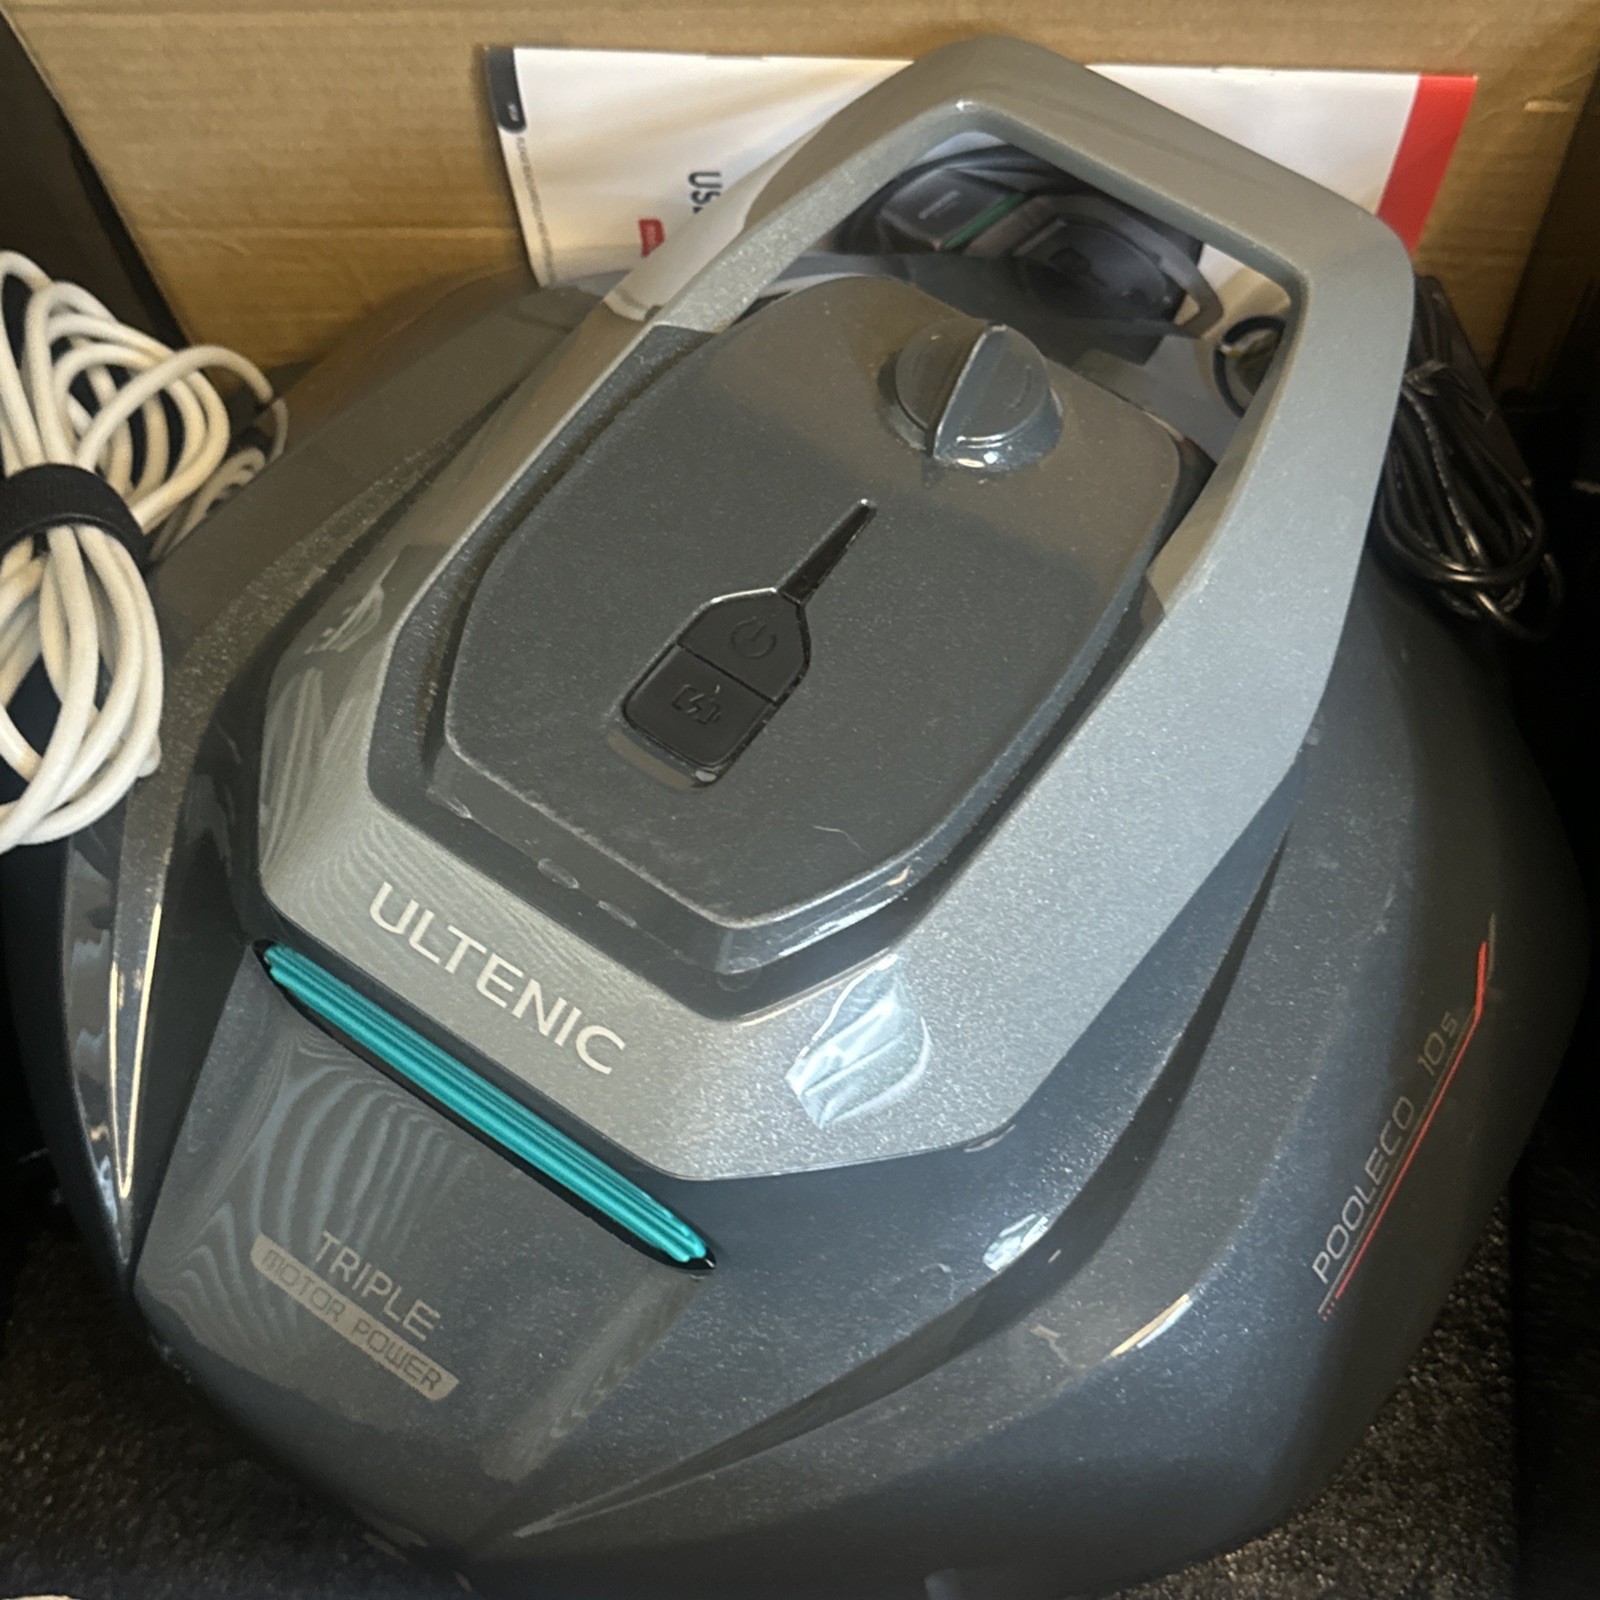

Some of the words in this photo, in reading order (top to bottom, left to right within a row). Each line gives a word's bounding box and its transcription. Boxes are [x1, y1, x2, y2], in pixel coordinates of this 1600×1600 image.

[688, 171, 721, 214] US
[370, 881, 625, 1075] ULTENIC
[1312, 1095, 1415, 1284] POOLECO
[262, 1250, 346, 1323] MOTOR
[351, 1319, 442, 1391] POWER
[315, 1231, 441, 1341] TRIPLE
